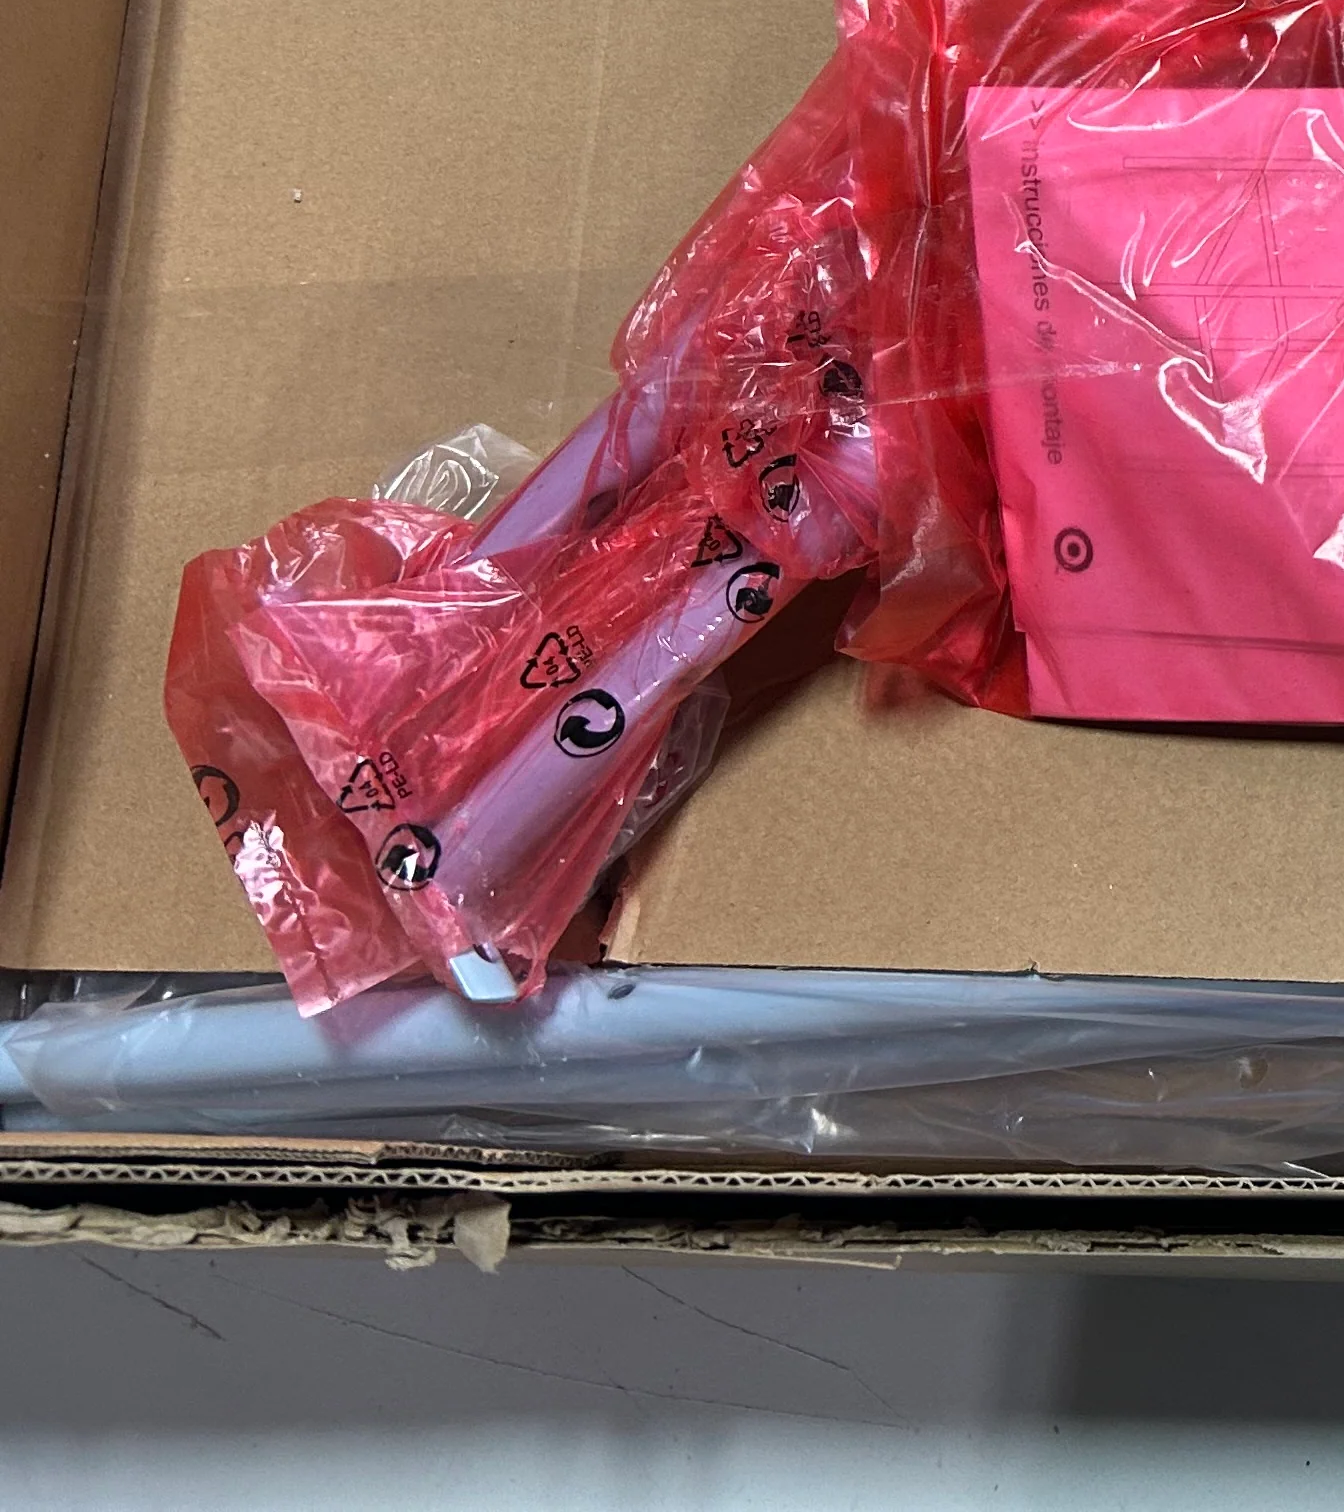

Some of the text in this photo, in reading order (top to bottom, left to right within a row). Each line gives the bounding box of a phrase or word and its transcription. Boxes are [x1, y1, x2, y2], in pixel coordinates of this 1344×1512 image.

[542, 656, 559, 676] 04
[379, 751, 413, 799] PE-LD
[358, 780, 379, 798] 04
